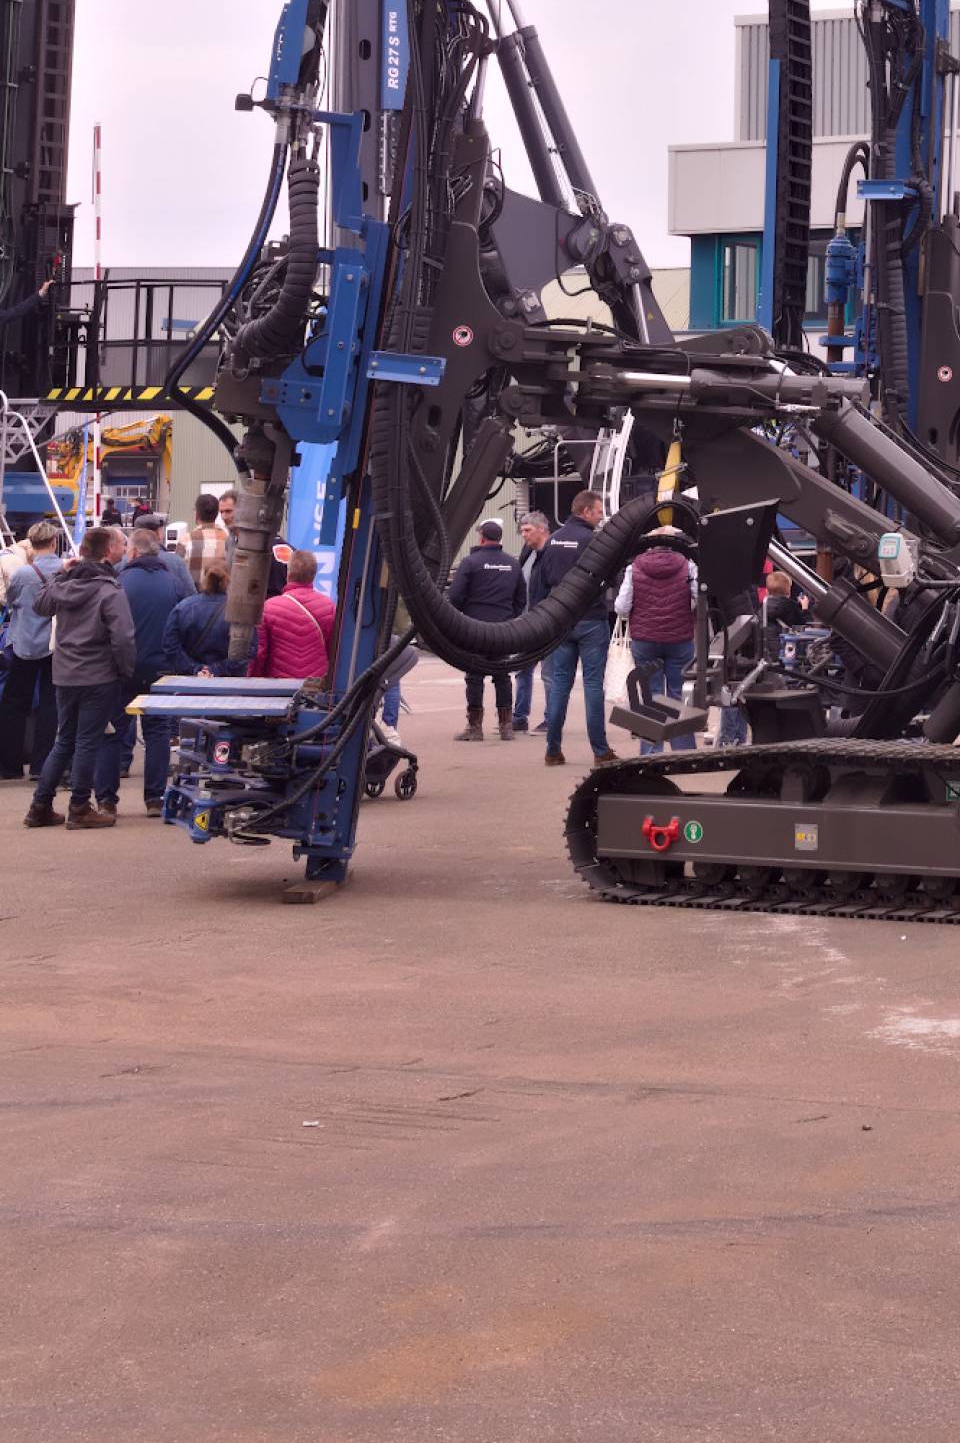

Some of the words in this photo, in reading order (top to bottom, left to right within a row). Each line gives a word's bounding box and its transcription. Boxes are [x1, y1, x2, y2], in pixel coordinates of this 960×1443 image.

[389, 36, 399, 47] S
[388, 49, 399, 66] 27
[387, 68, 399, 90] RG
